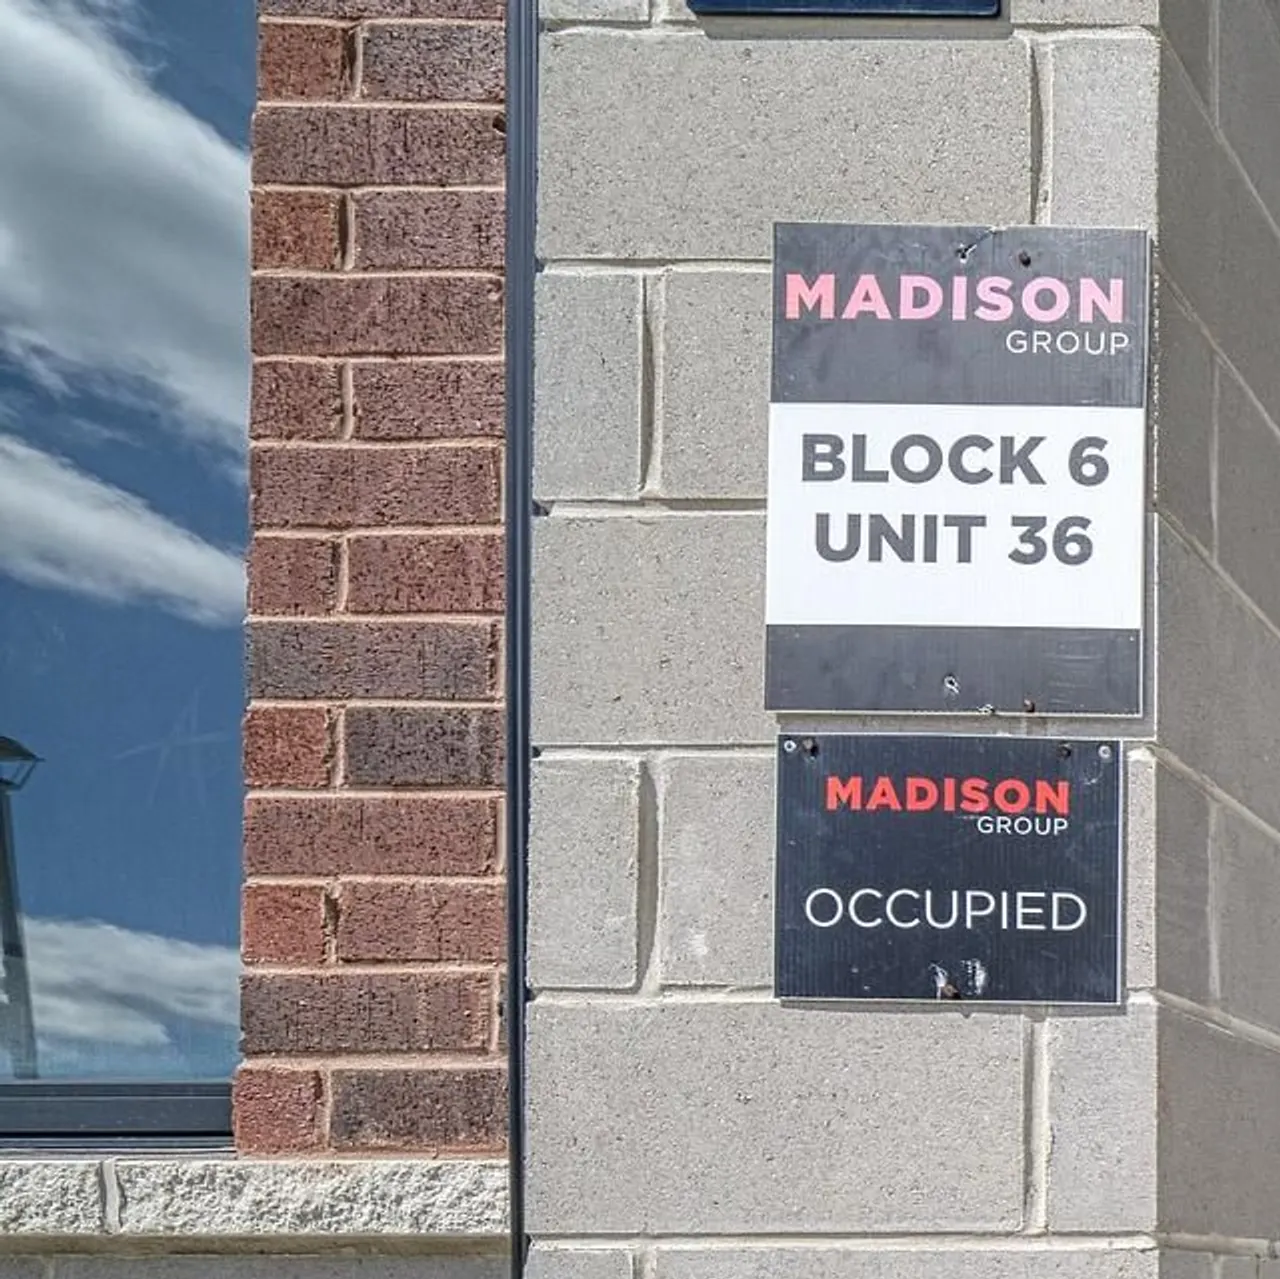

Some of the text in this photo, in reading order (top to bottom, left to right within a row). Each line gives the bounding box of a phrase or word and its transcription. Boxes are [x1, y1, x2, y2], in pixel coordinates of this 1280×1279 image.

[784, 272, 1123, 323] MADISON
[1005, 330, 1129, 355] GROUP
[801, 433, 1110, 487] BLOCK 6
[815, 513, 1093, 566] UNIT 36
[826, 775, 1070, 815] MADISON
[977, 816, 1068, 836] GROUP
[805, 888, 1087, 931] OCCUPIED
